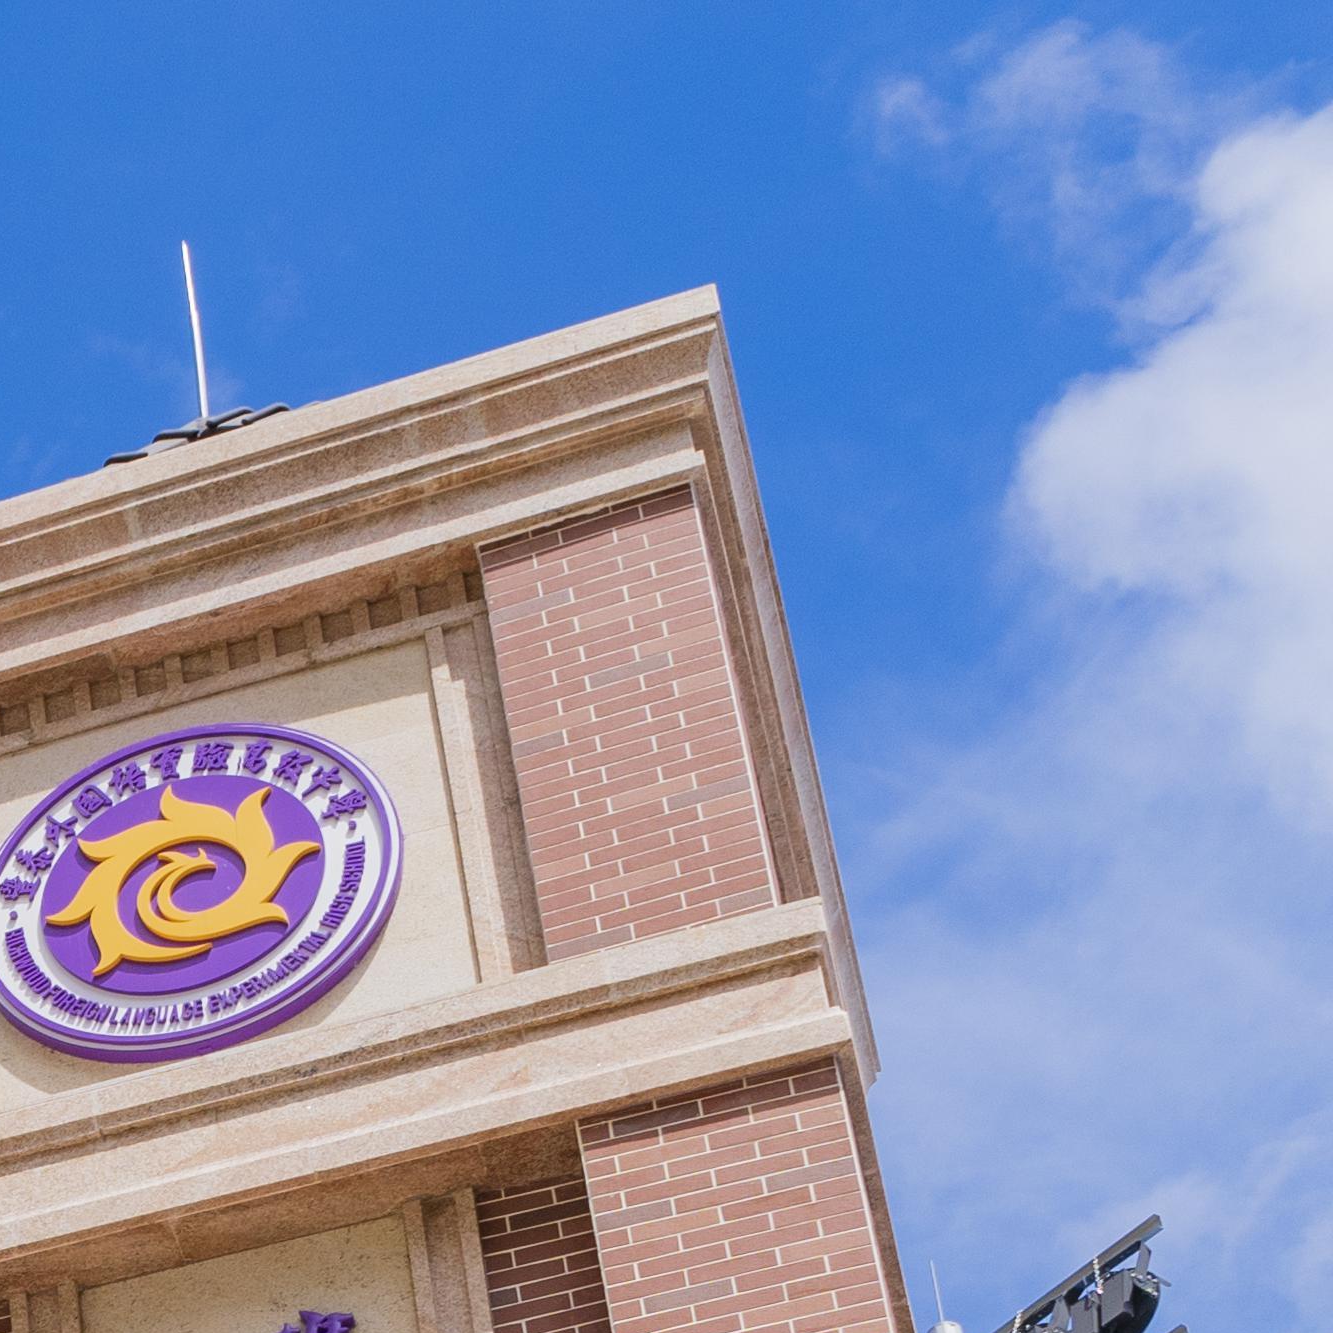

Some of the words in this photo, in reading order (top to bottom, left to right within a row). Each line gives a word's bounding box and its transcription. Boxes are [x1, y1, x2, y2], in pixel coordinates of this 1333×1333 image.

[109, 999, 204, 1026] LANGUAGE
[208, 931, 331, 1014] EXPERIMENTAL
[319, 894, 355, 930] HIGH
